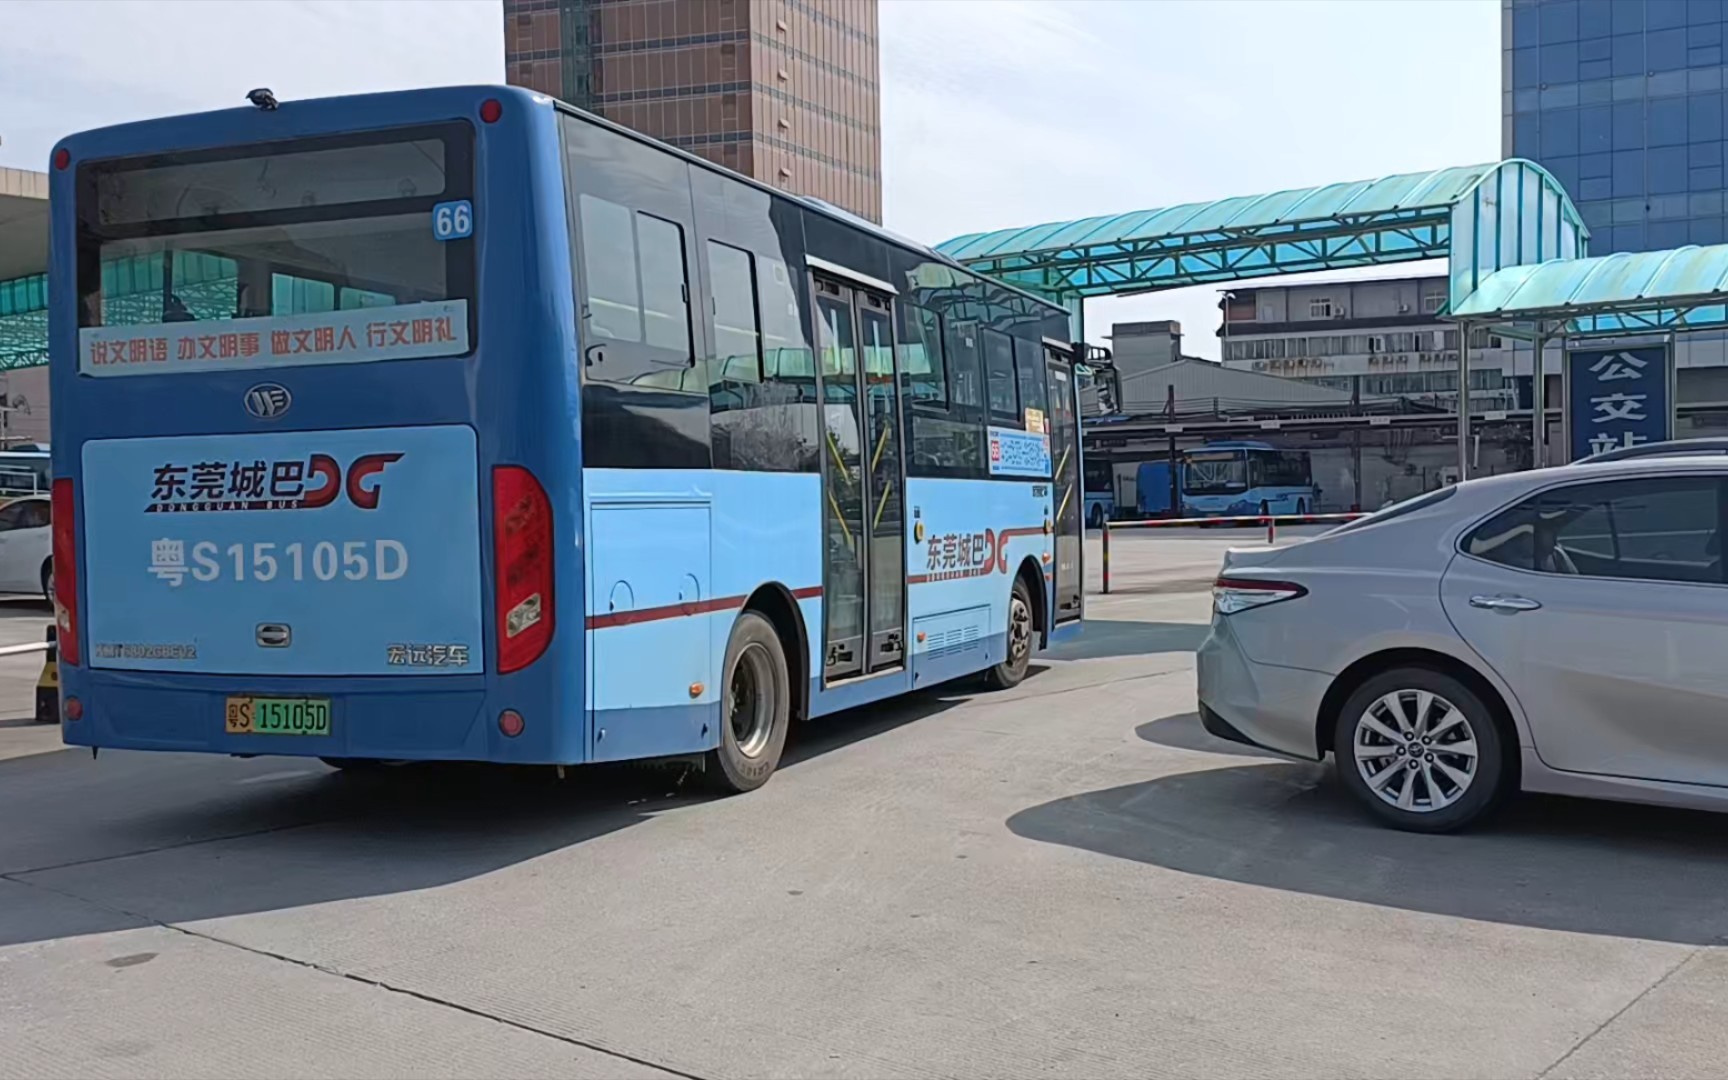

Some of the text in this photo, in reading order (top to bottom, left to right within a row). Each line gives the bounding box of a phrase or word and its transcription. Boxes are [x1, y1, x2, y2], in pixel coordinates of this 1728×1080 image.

[437, 205, 469, 236] 66
[90, 316, 457, 365] 说文明语 办文明事 做文明人 行文明礼
[151, 461, 304, 501] 东莞城巴
[156, 499, 298, 513] DONGGUAN BUS
[147, 537, 409, 587] 粤S15105D
[926, 532, 985, 571] 东莞城巴
[387, 643, 469, 667] 宏远汽车
